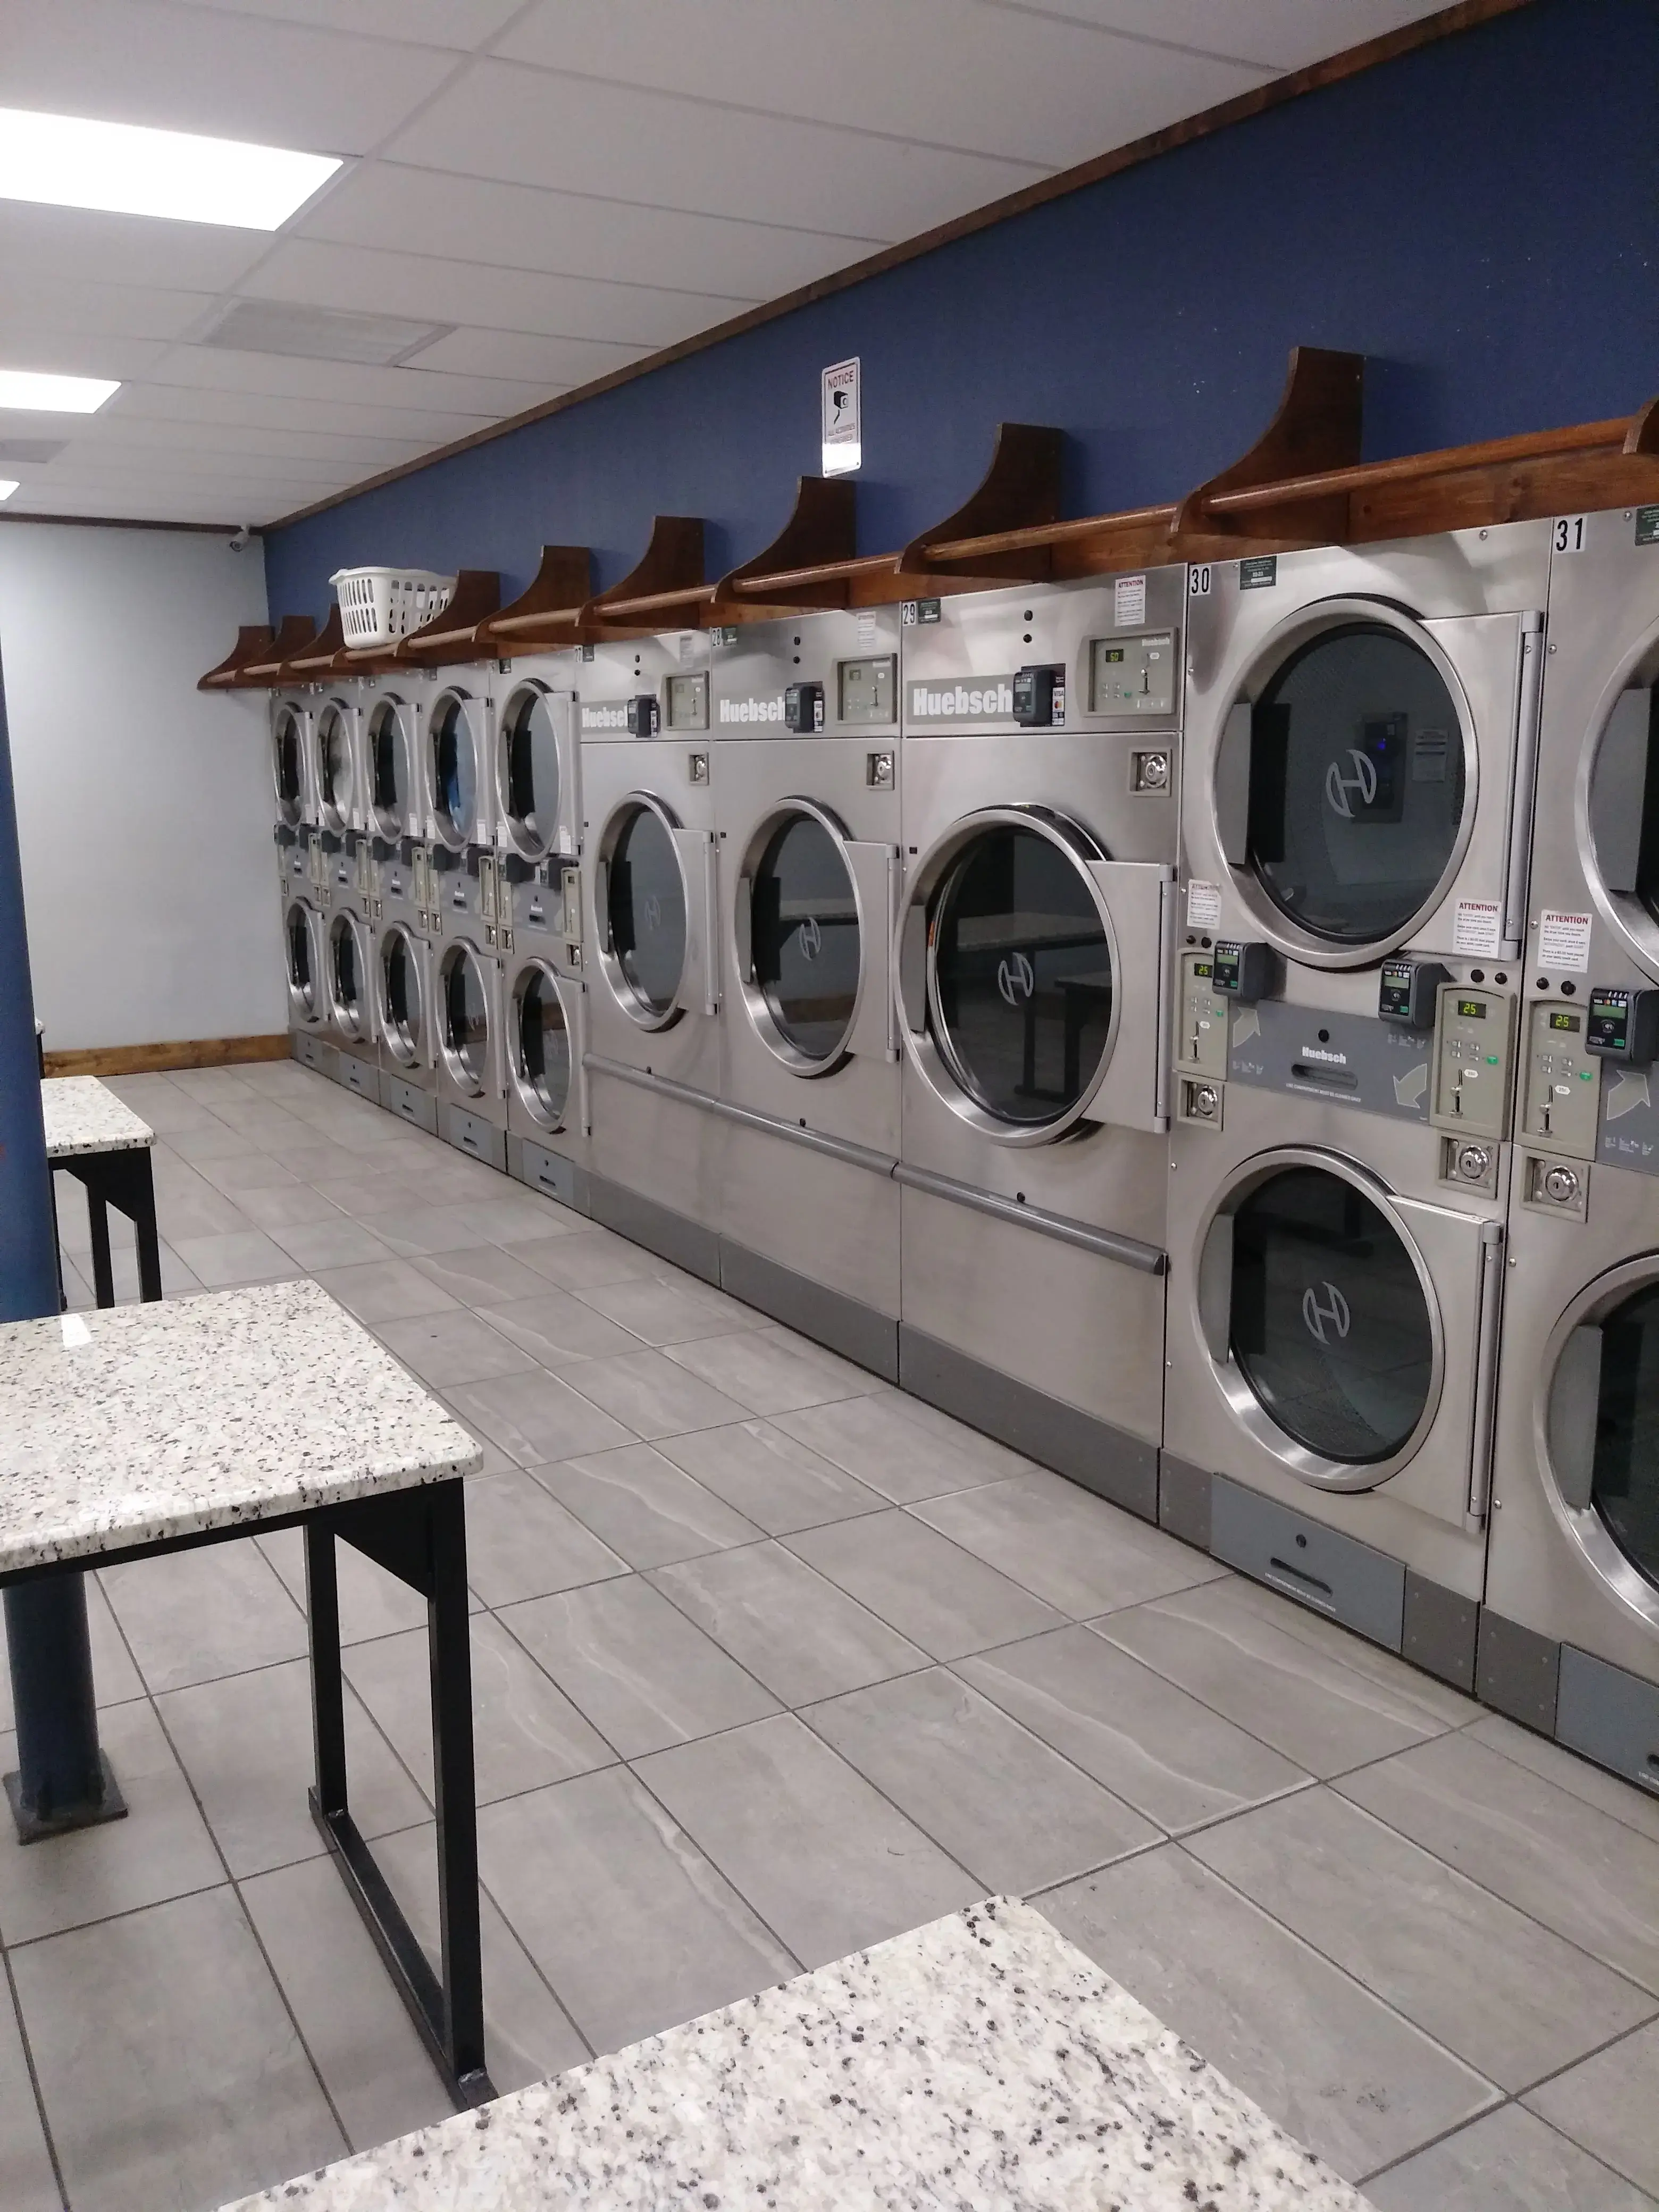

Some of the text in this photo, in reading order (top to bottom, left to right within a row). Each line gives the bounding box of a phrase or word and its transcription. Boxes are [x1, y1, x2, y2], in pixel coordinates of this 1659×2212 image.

[828, 370, 854, 389] NOTICE
[1556, 518, 1583, 551] 31
[1192, 567, 1209, 593] 30
[903, 604, 915, 624] 29
[914, 684, 1013, 716] Huebsch
[1459, 902, 1498, 912] ATTENTION
[1546, 915, 1588, 925] ATTENTION
[1199, 966, 1208, 975] 25
[1463, 1003, 1477, 1015] 25
[1555, 1015, 1569, 1027] 25
[1302, 1046, 1346, 1065] Huebsch
